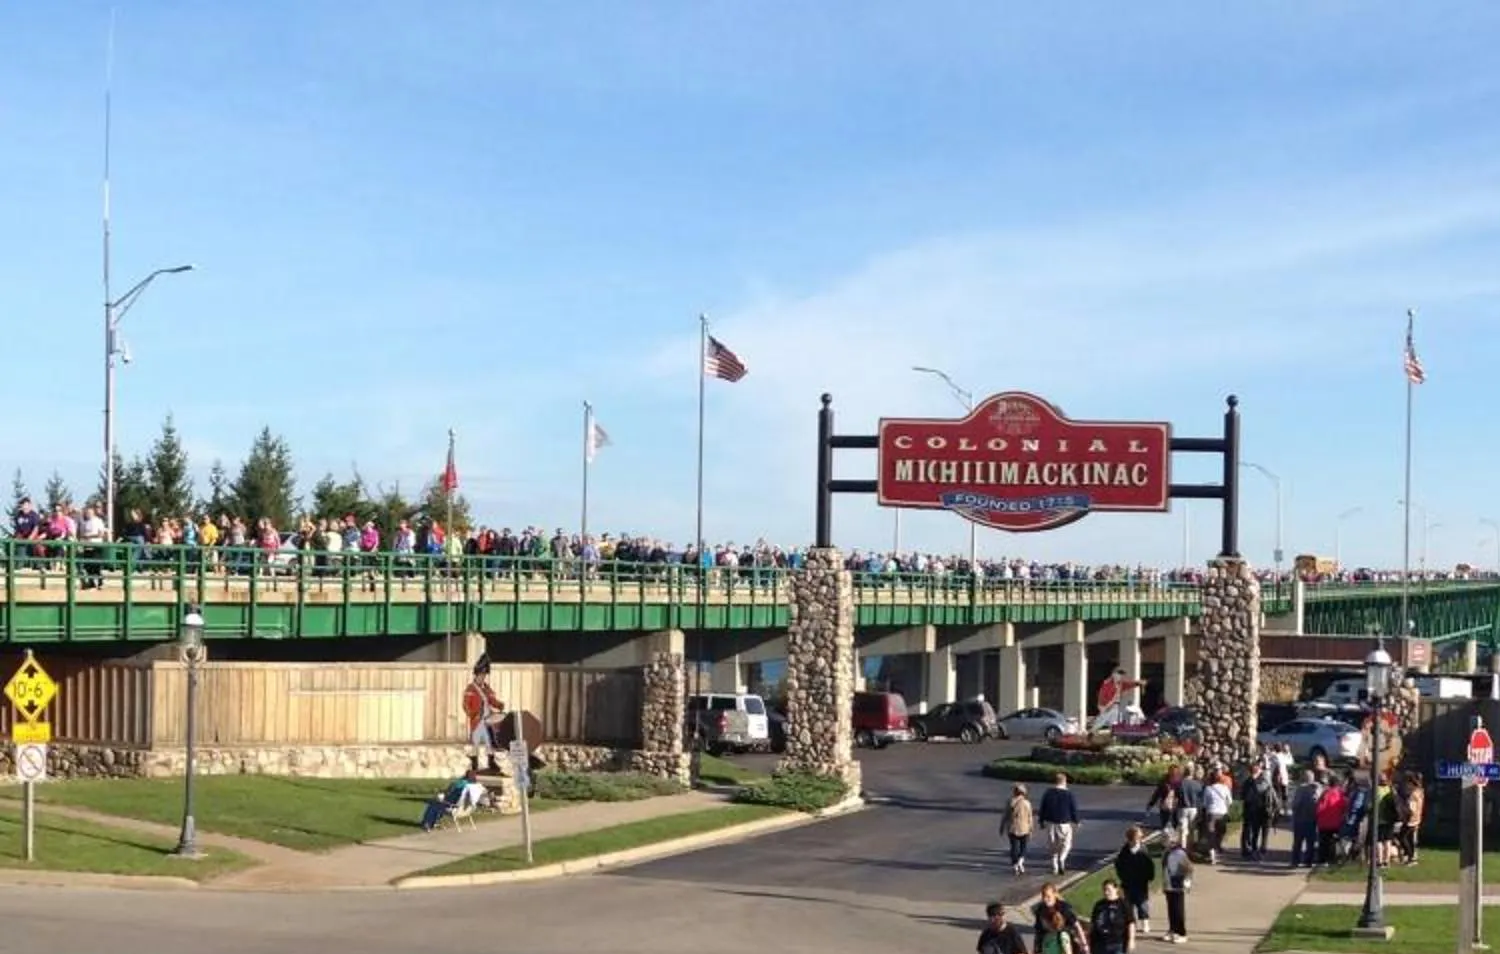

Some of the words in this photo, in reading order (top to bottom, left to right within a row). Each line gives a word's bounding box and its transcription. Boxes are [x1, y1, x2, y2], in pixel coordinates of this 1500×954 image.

[895, 437, 1147, 452] COLONIAL
[895, 459, 1148, 486] MICHILIMACKINAC
[955, 493, 1031, 511] FOUNDED
